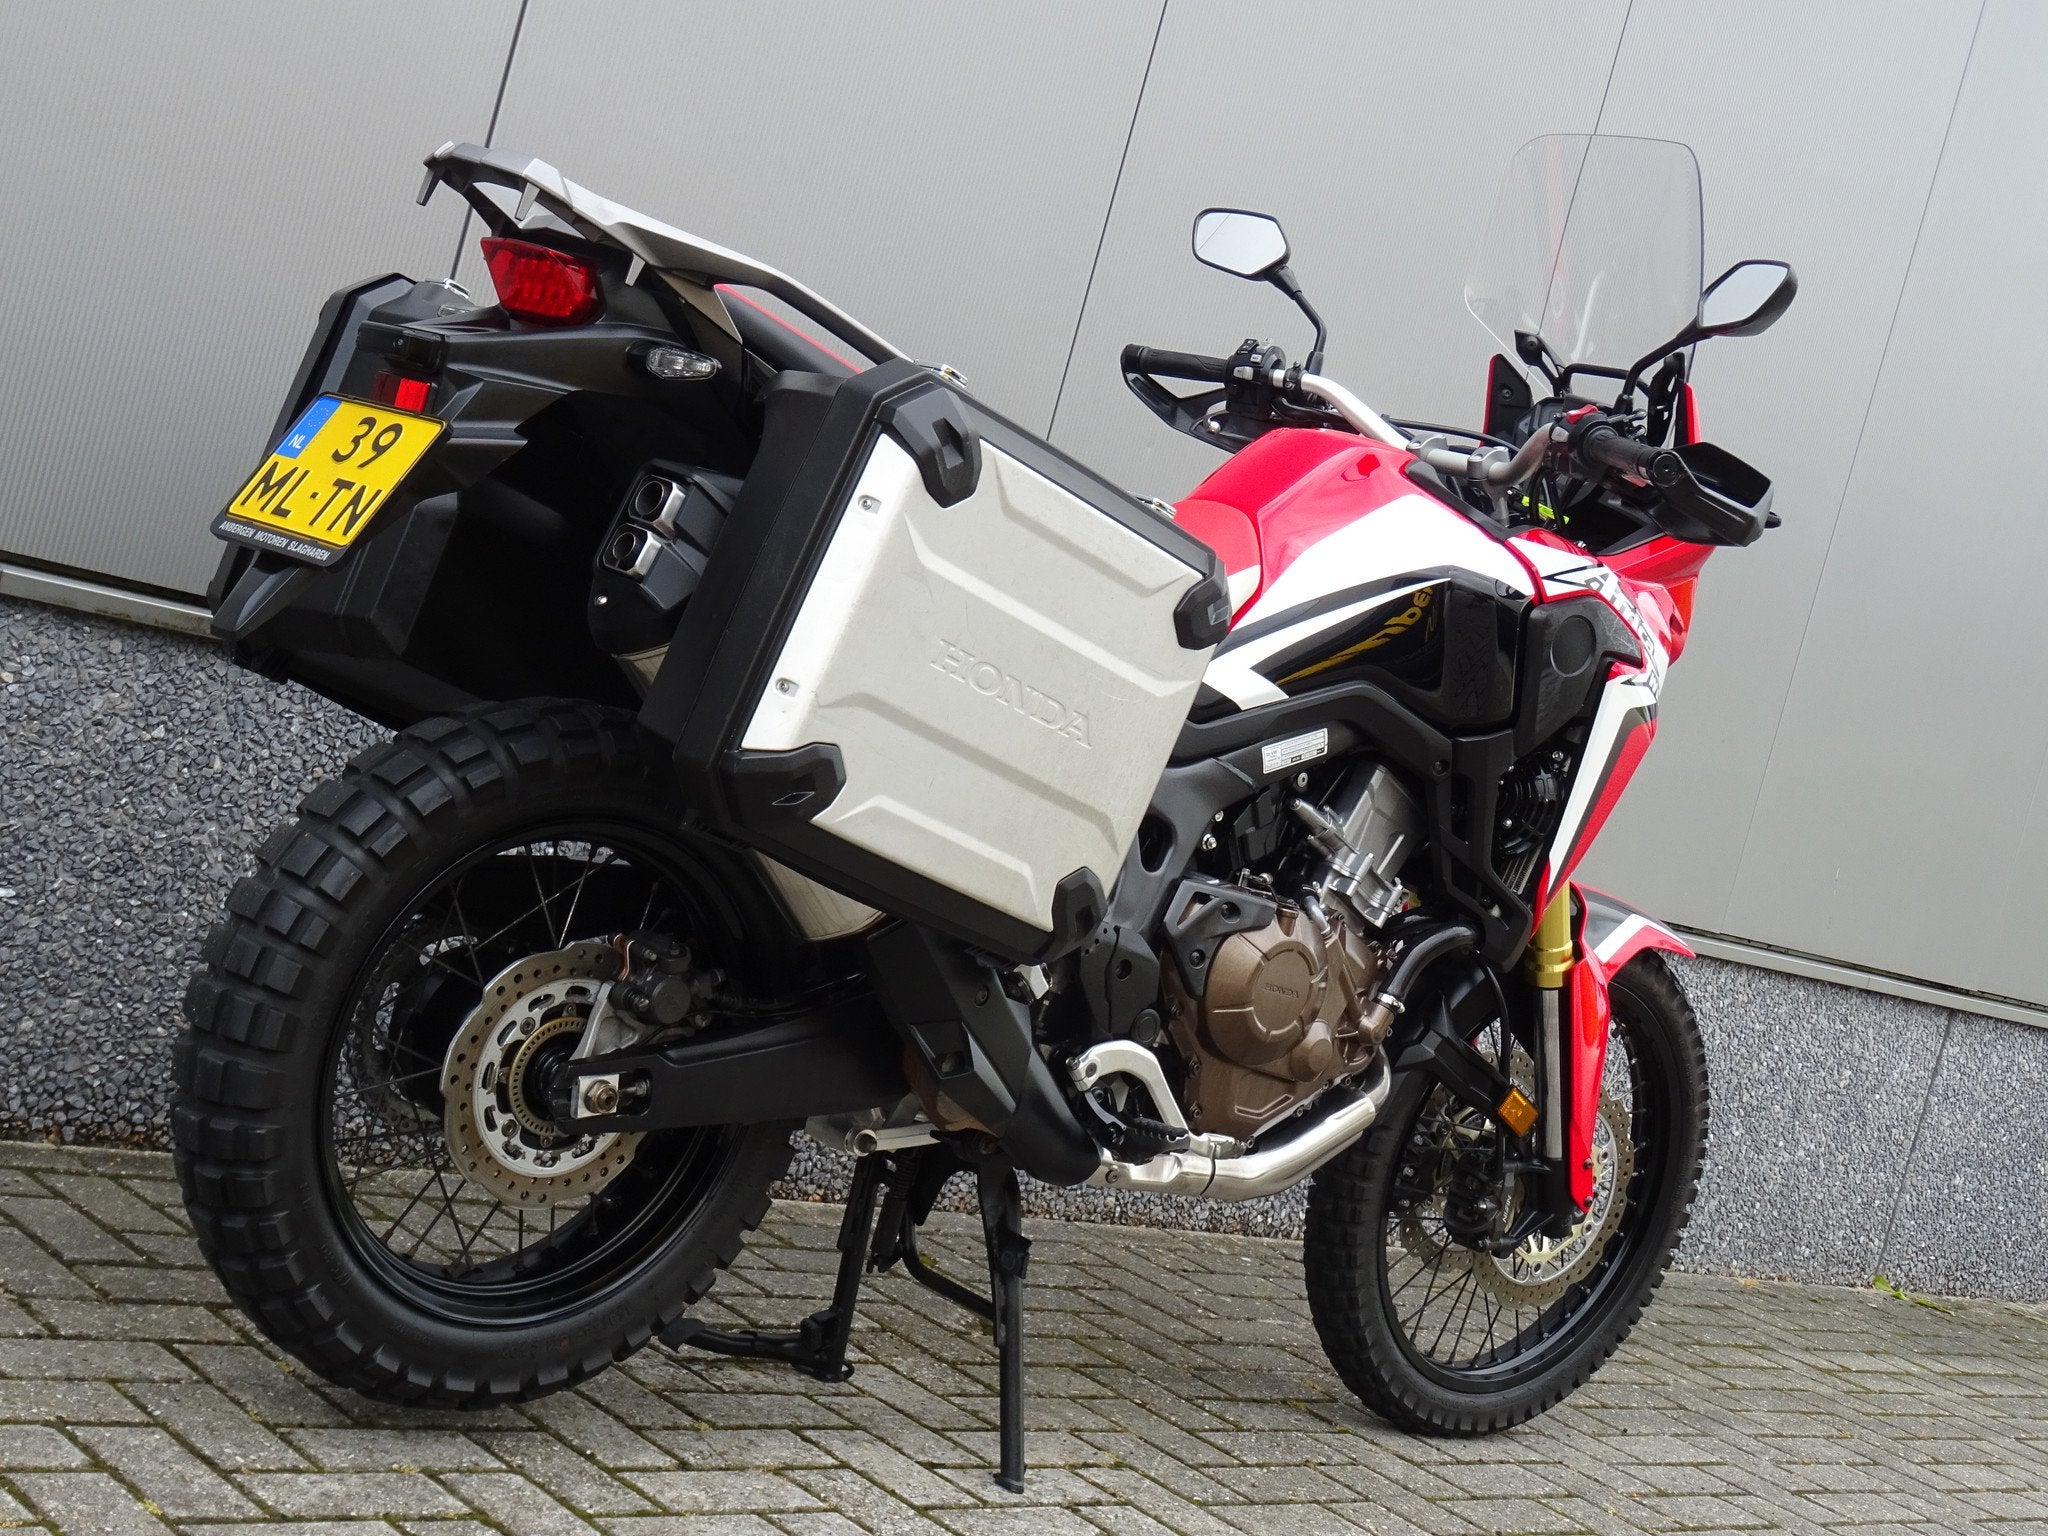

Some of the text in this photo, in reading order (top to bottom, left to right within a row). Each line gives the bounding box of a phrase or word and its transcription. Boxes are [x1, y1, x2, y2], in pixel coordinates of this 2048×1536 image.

[288, 433, 305, 450] NL
[331, 416, 404, 469] 39
[219, 520, 331, 561] ANBERGEN MOTOREN SLAGHAREN
[929, 638, 1093, 750] HONDA
[1264, 982, 1300, 999] HONDA
